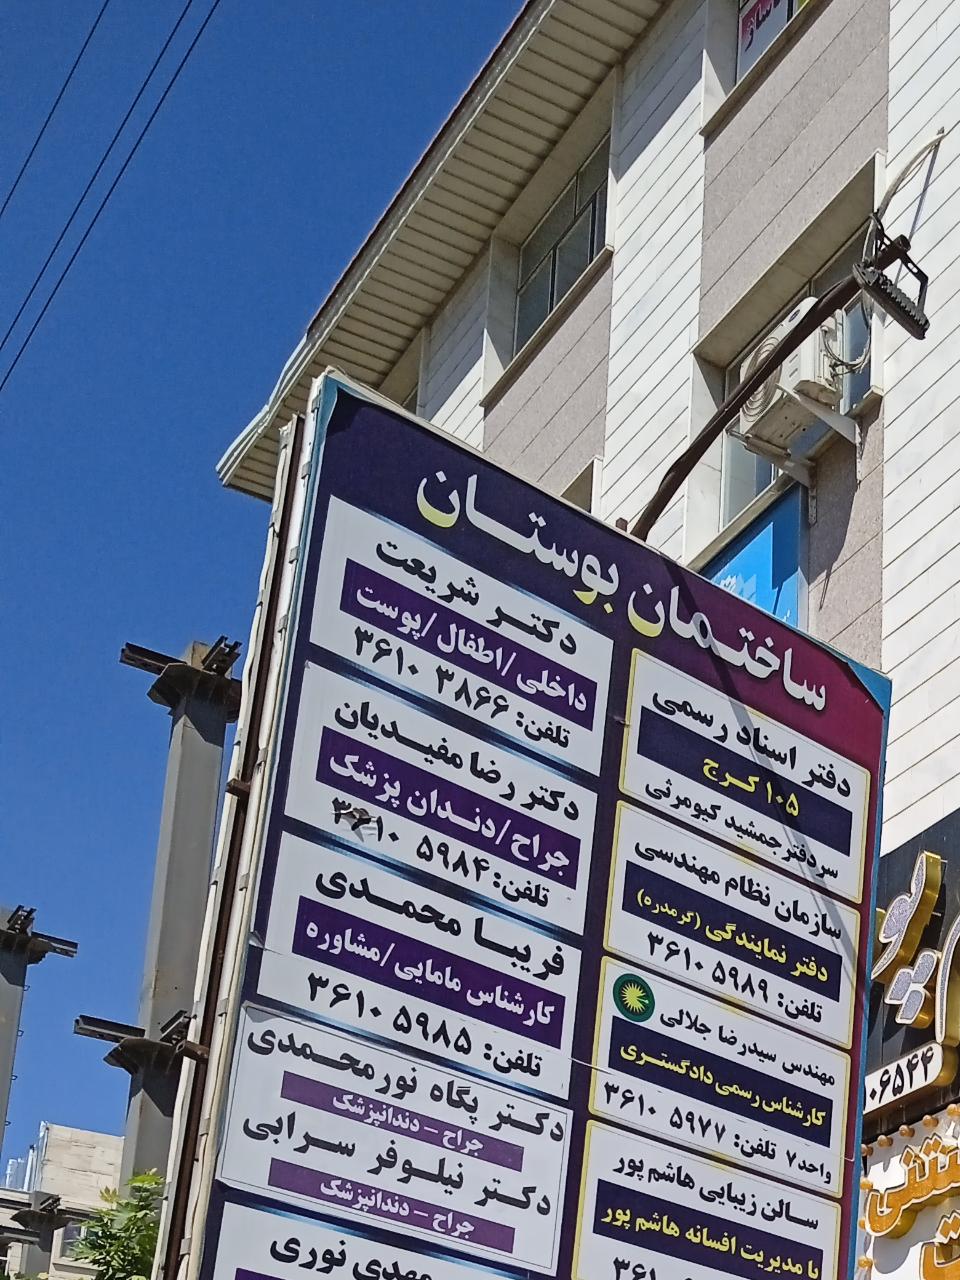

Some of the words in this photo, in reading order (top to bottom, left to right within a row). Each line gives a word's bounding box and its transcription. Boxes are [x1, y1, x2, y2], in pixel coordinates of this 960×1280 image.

[416, 471, 621, 614] بوستان
[375, 541, 480, 605] شریعت
[486, 606, 577, 655] دکتر
[627, 583, 827, 712] ساختمان
[354, 625, 419, 676] ۳۶۱۰
[436, 665, 509, 719] ۳۸۶۶
[334, 701, 463, 769] مفیدیان
[516, 711, 571, 748] تلفن:
[652, 692, 729, 742] رسمی
[736, 726, 797, 771] اسناد
[470, 752, 516, 801] رضا
[702, 757, 760, 793] کرج
[802, 763, 850, 798] دفتر
[520, 785, 580, 821] دکتر
[725, 816, 782, 856] جمشید
[416, 835, 490, 882] ۵۹۸۴
[634, 842, 721, 885] مهندسی
[315, 871, 461, 936] محمدی
[493, 872, 549, 908] تلفن:
[724, 875, 771, 907] نظام
[774, 901, 842, 939] سازمان
[474, 917, 565, 980] فریبا
[647, 931, 704, 971] ۳۶۱۰
[705, 922, 787, 965] نمایندگی
[711, 960, 768, 1003] ۵۹۸۹
[790, 956, 829, 982] دفتر
[307, 972, 382, 1018] ۳۶۱۰
[466, 985, 554, 1026] کارشناس
[777, 993, 822, 1024] تلفن:
[392, 1005, 471, 1055] ۵۹۸۵
[659, 1009, 712, 1040] جلالی
[484, 1043, 543, 1076] تلفن:
[620, 1044, 714, 1085] دادگستری
[781, 1062, 836, 1087] مهندس
[430, 1080, 479, 1125] پگاه
[603, 1081, 656, 1116] ۳۶۱۰
[714, 1078, 759, 1107] رسمی
[761, 1096, 827, 1127] کارشناس
[243, 1112, 356, 1158] سرابی
[489, 1103, 564, 1142] دکتر
[669, 1106, 726, 1143] ۵۹۷۷
[442, 1128, 484, 1157] جراح
[733, 1133, 777, 1160] تلفن:
[367, 1139, 463, 1197] نیلوفر
[613, 1156, 644, 1181] پور
[647, 1162, 696, 1190] هاشم
[474, 1178, 551, 1216] دکتر
[760, 1199, 819, 1230] سالن
[432, 1210, 475, 1239] جراح
[600, 1205, 631, 1231] پور
[635, 1212, 680, 1238] هاشم
[269, 1237, 347, 1274] نوری
[685, 1226, 737, 1255] افسانه
[740, 1244, 803, 1275] مدیریت
